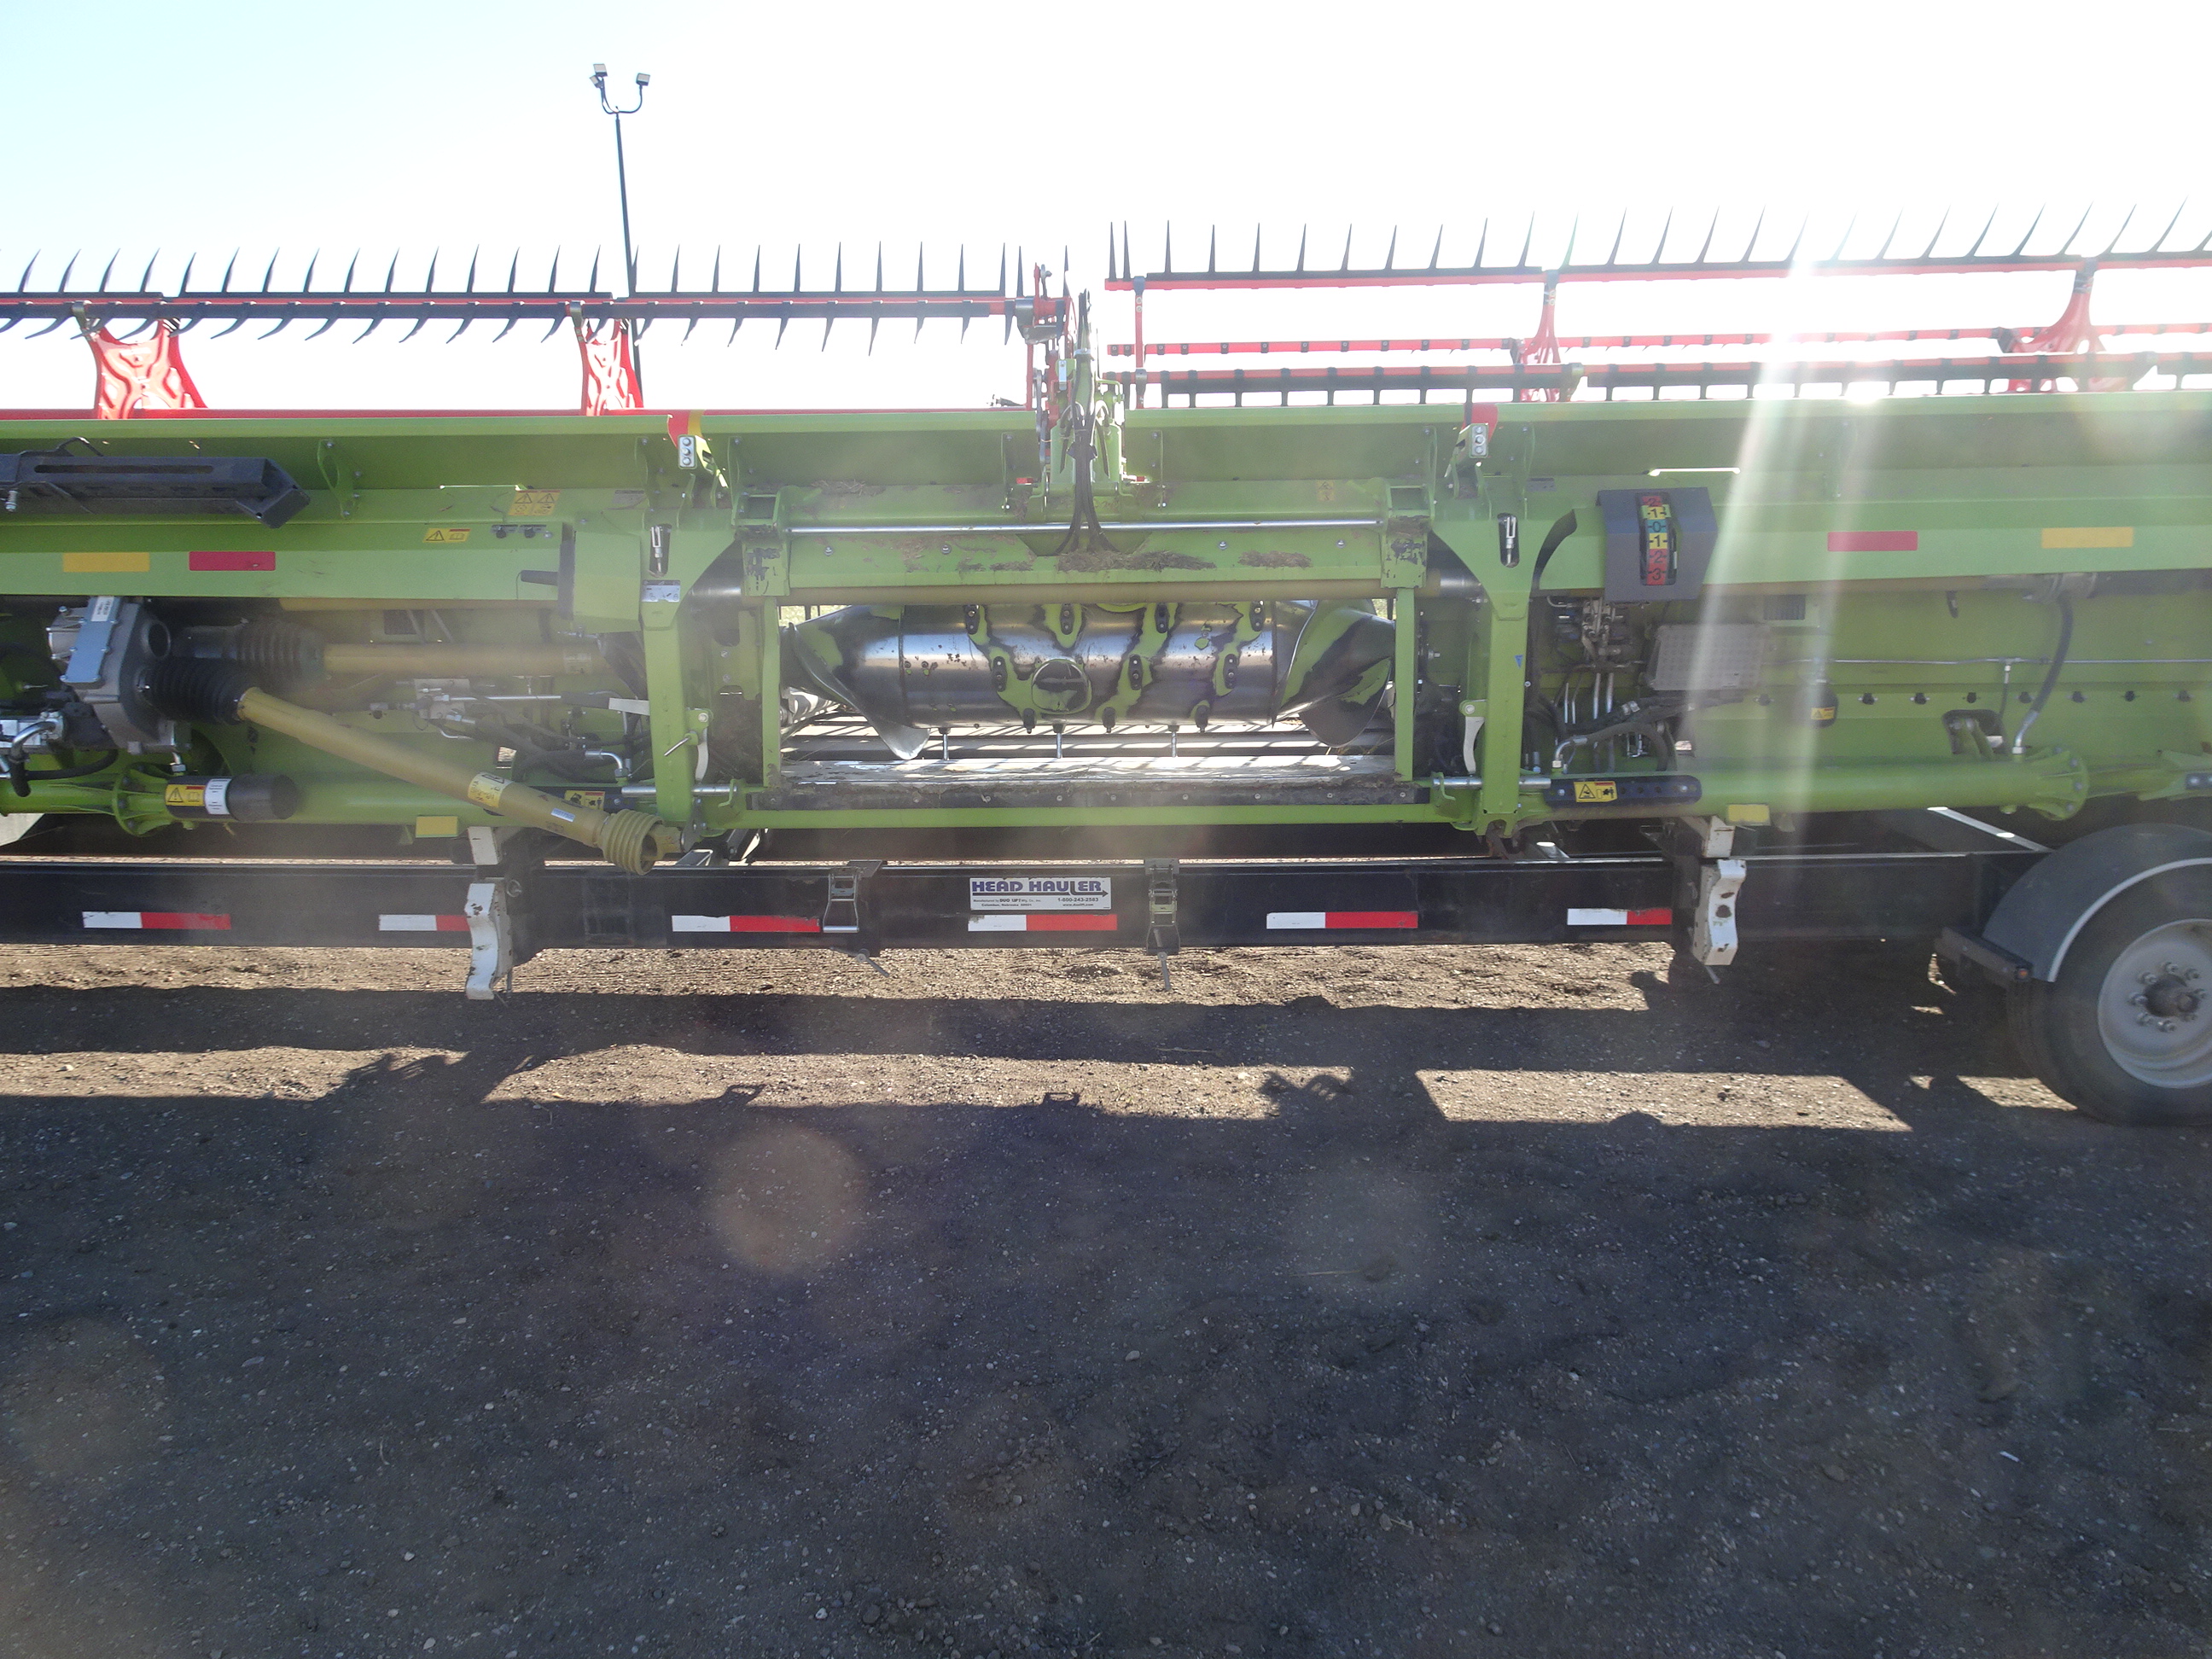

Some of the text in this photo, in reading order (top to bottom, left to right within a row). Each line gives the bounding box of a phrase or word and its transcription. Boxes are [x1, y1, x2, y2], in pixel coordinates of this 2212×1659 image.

[1653, 550, 1663, 563] 2
[1652, 568, 1662, 580] 3
[971, 880, 1102, 894] HEAD HAULER
